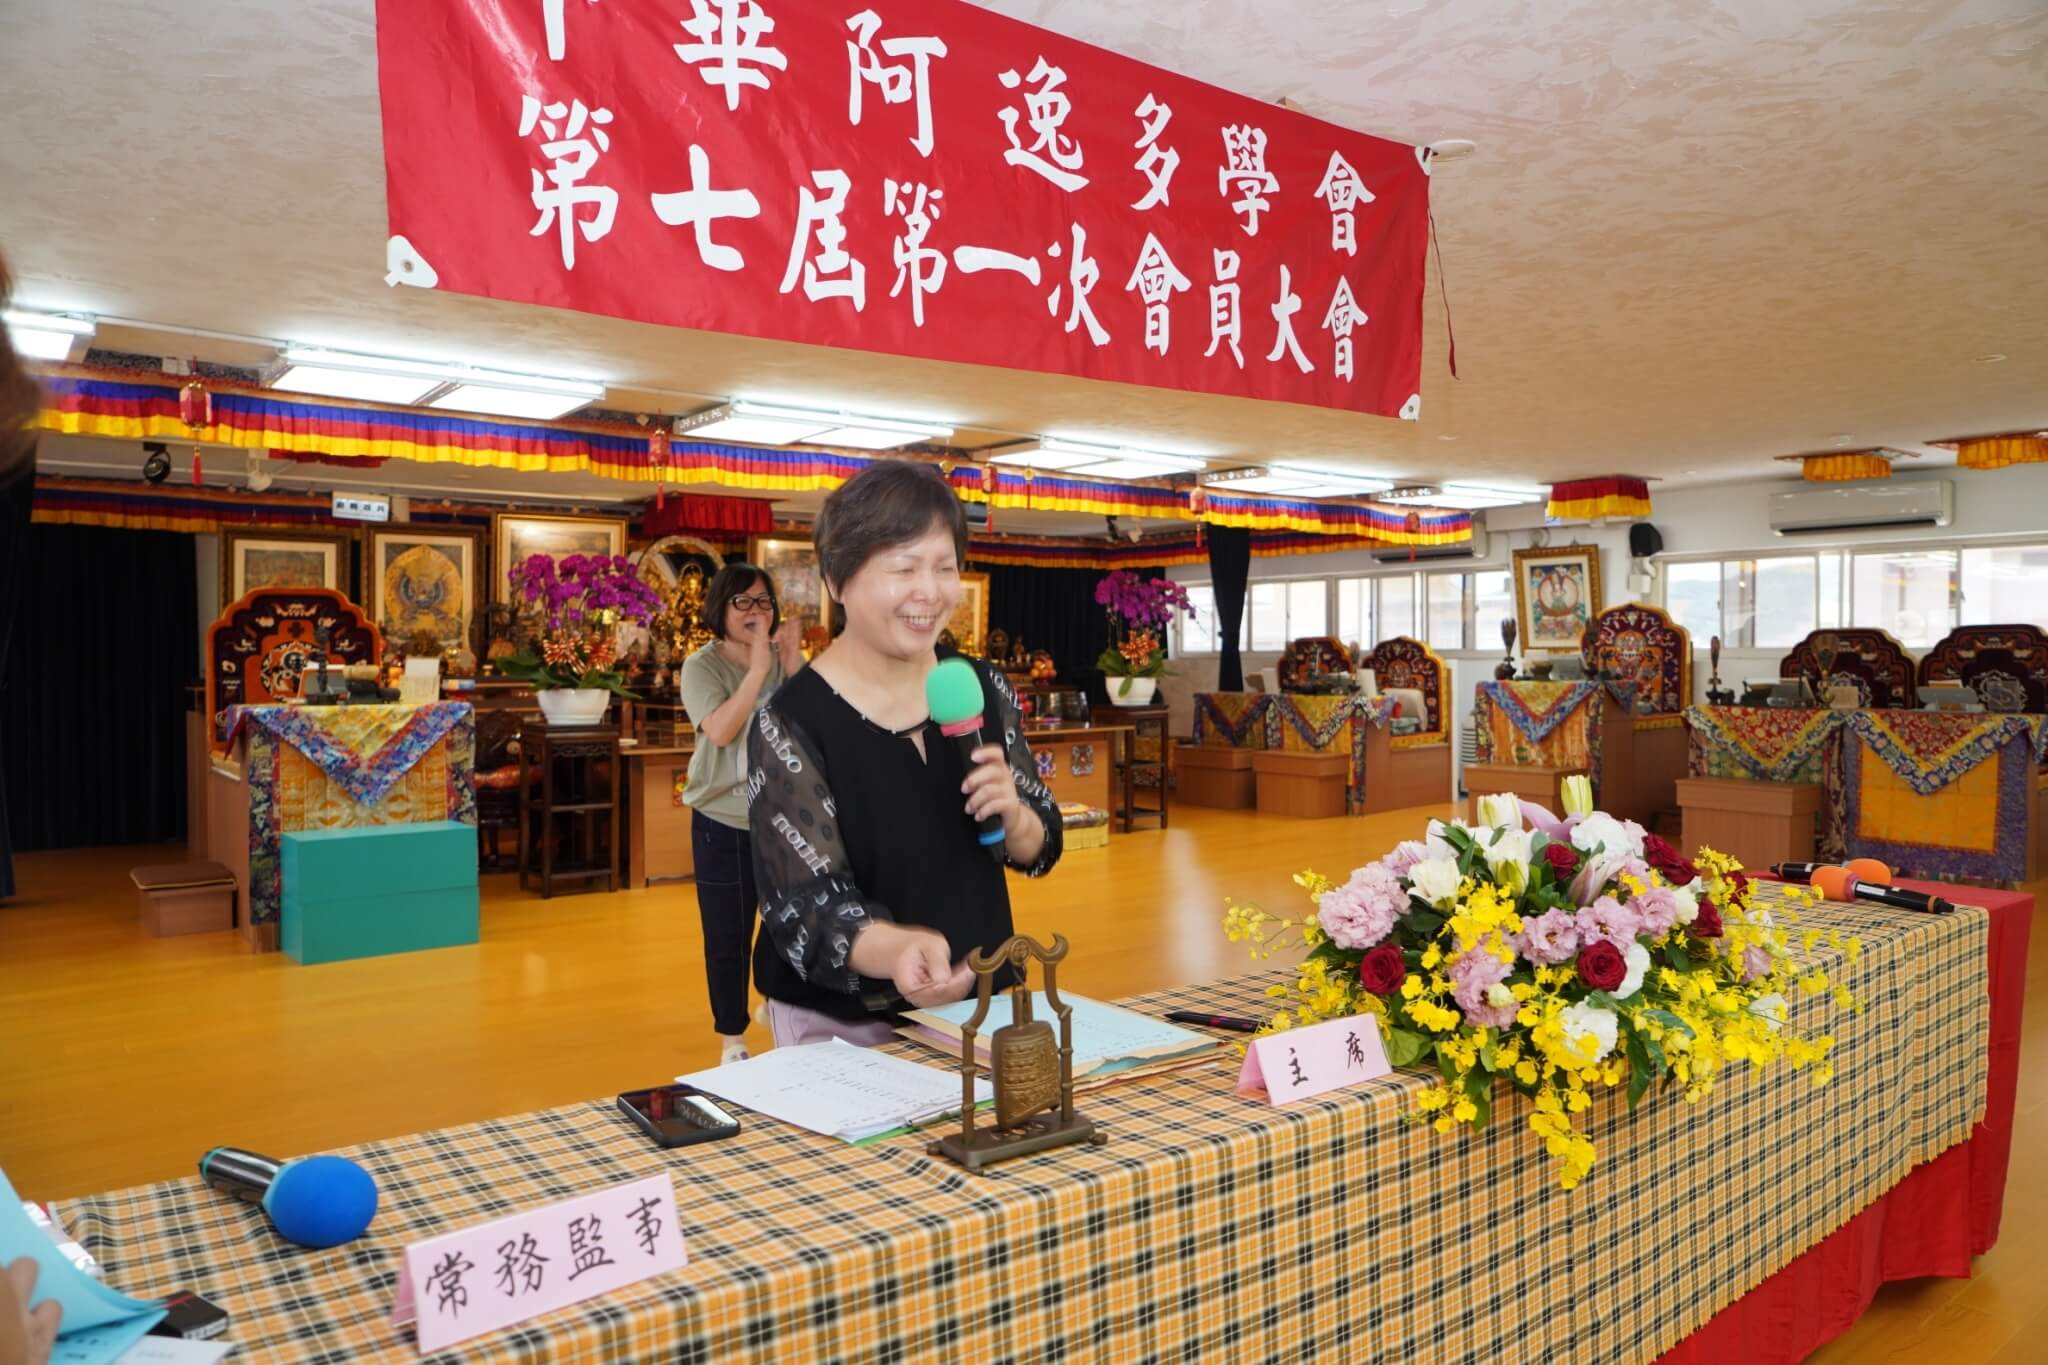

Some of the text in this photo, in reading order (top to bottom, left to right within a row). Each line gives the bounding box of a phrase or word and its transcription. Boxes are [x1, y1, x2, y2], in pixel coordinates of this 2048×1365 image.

[518, 94, 1370, 383] 第七屆第一次會員大會
[1287, 1031, 1365, 1088] 主席
[425, 1197, 662, 1320] 常務監事
